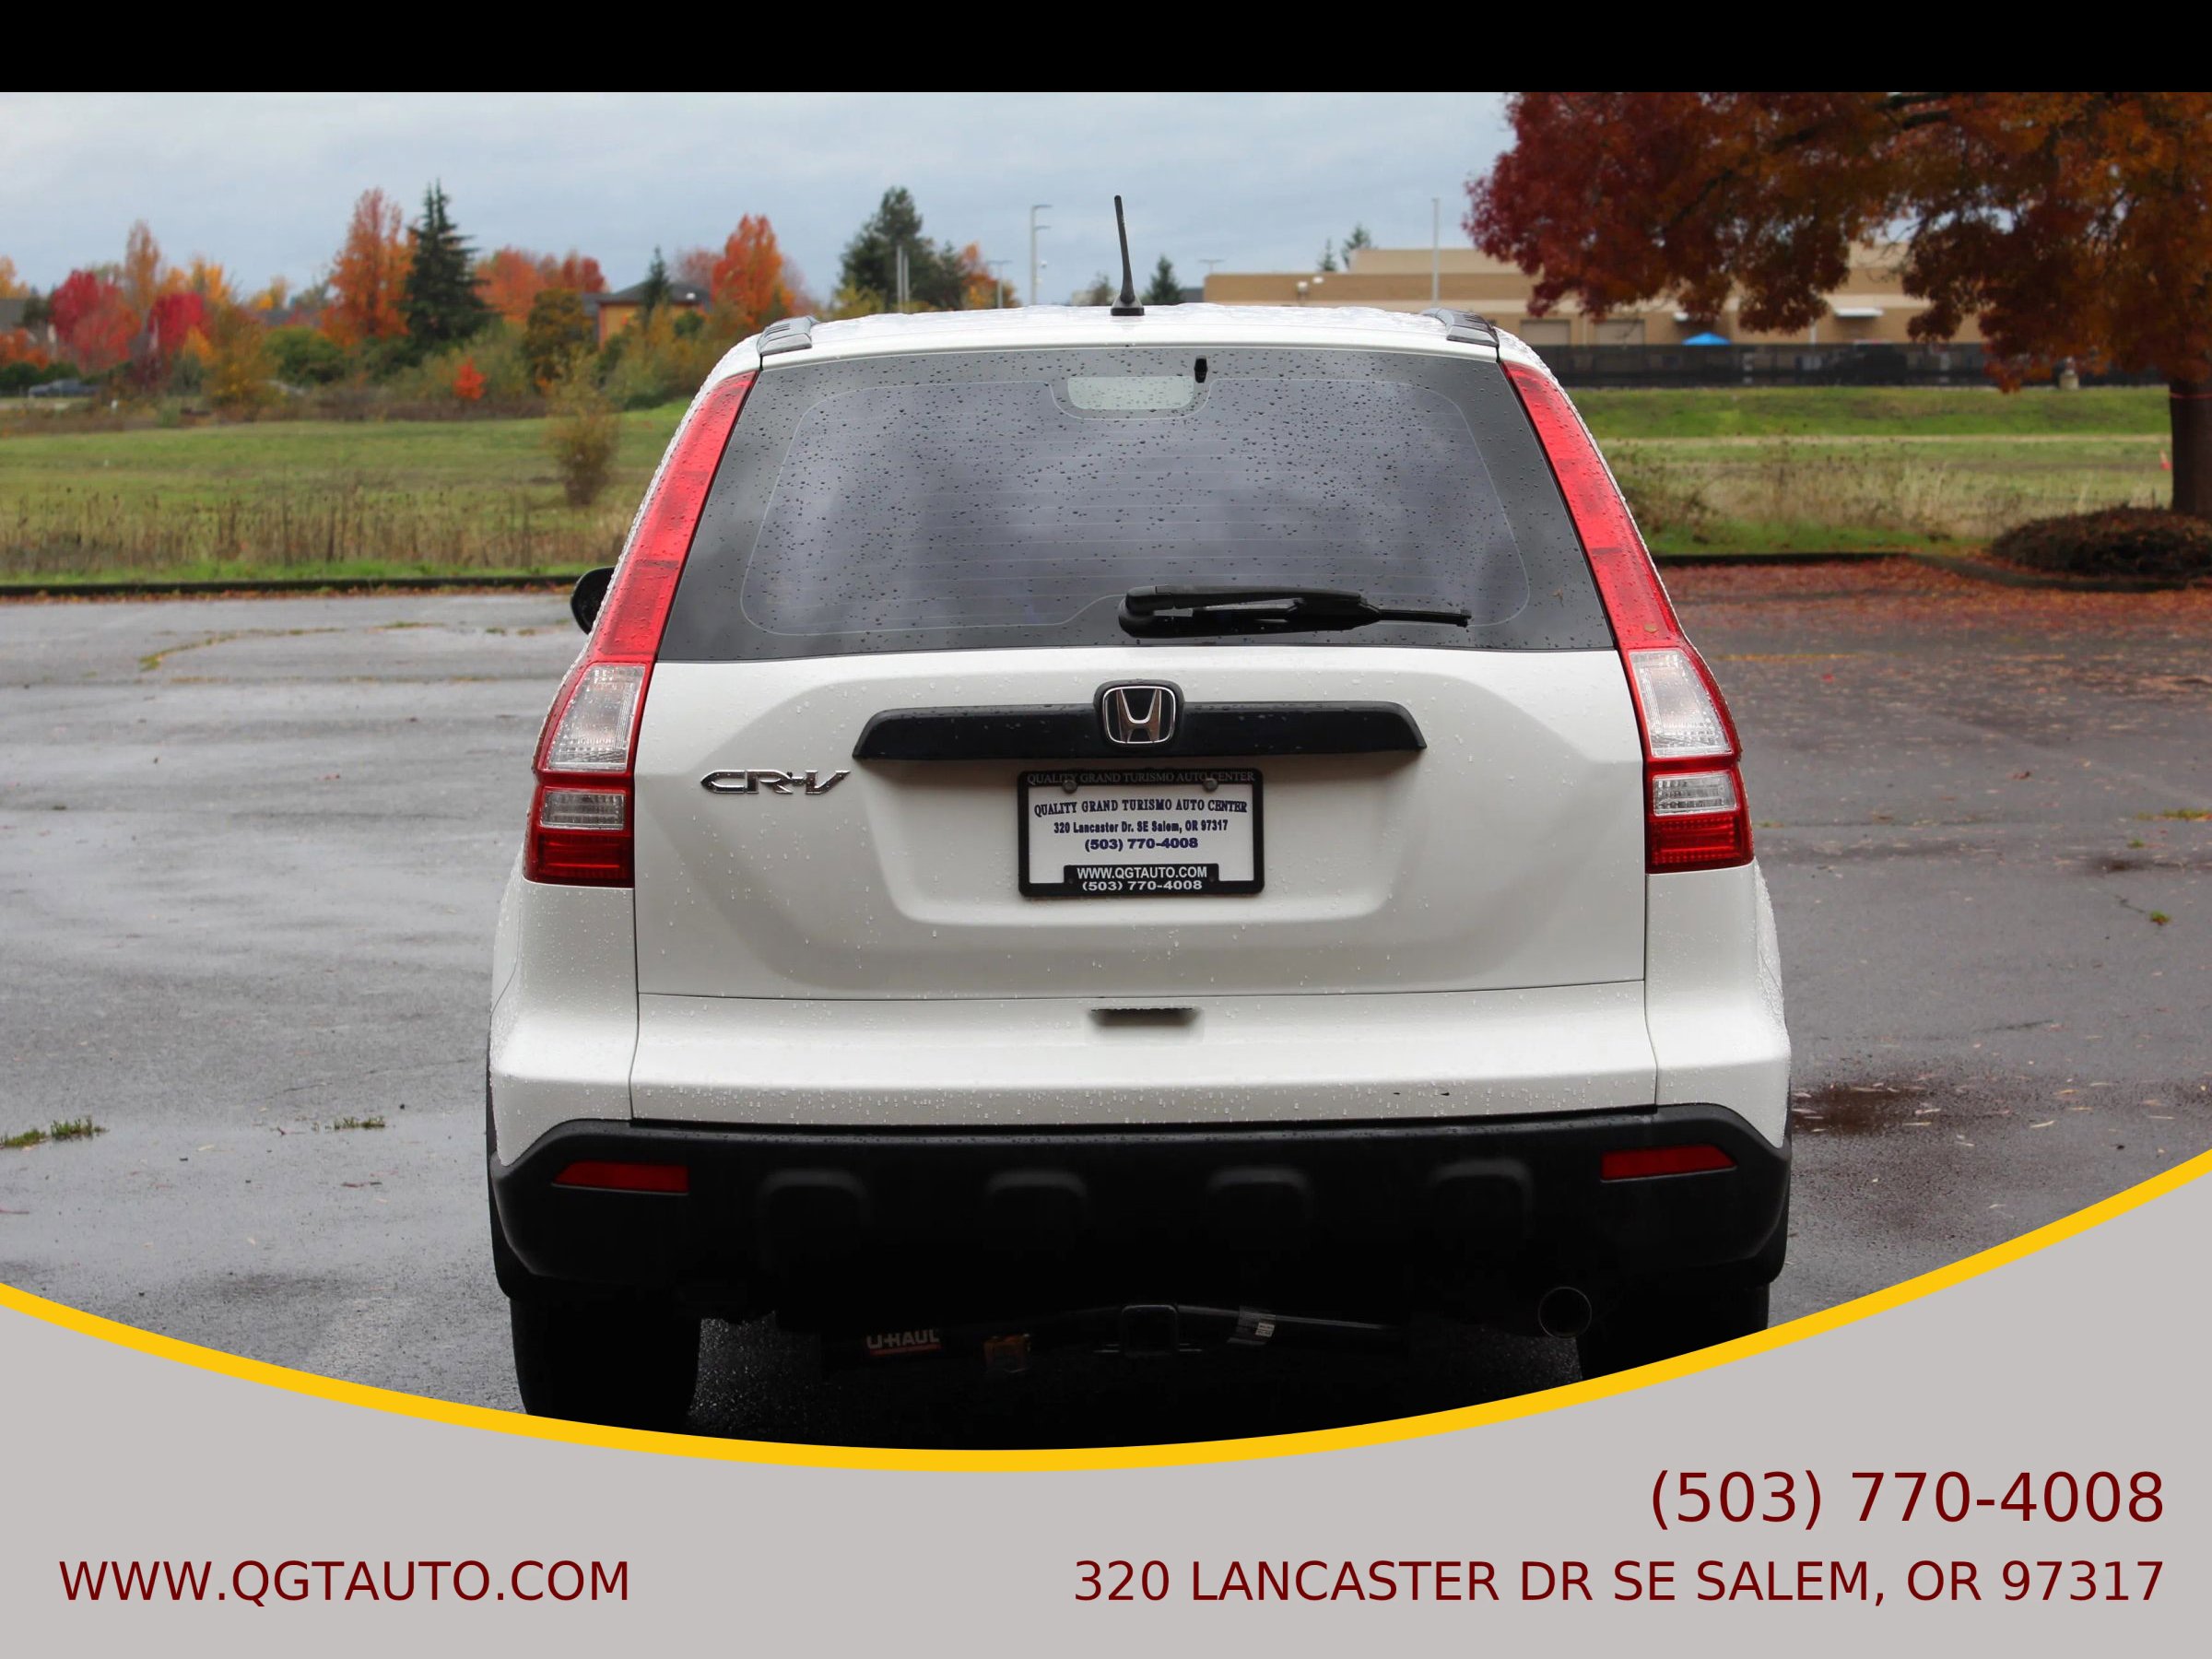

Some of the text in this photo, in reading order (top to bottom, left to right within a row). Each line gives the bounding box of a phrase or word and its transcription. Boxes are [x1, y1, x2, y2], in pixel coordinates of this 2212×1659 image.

[700, 769, 851, 794] CR-V
[1081, 772, 1122, 782] GRAND
[1123, 771, 1176, 782] TURISMO
[1178, 771, 1209, 782] AUTO
[1210, 771, 1255, 782] CENTER
[1034, 799, 1248, 818] QUALITY GRAND TURISMO AUTO CENTER
[1053, 819, 1229, 833] 320 Lancaster Dr. SE Salem, OR 97317
[1085, 837, 1198, 853] (503) 770-4008
[1077, 866, 1207, 879] WWW.QGTAUTO.COM
[1082, 880, 1203, 891] (503) 770-4008
[865, 1327, 940, 1349] U-HAUL
